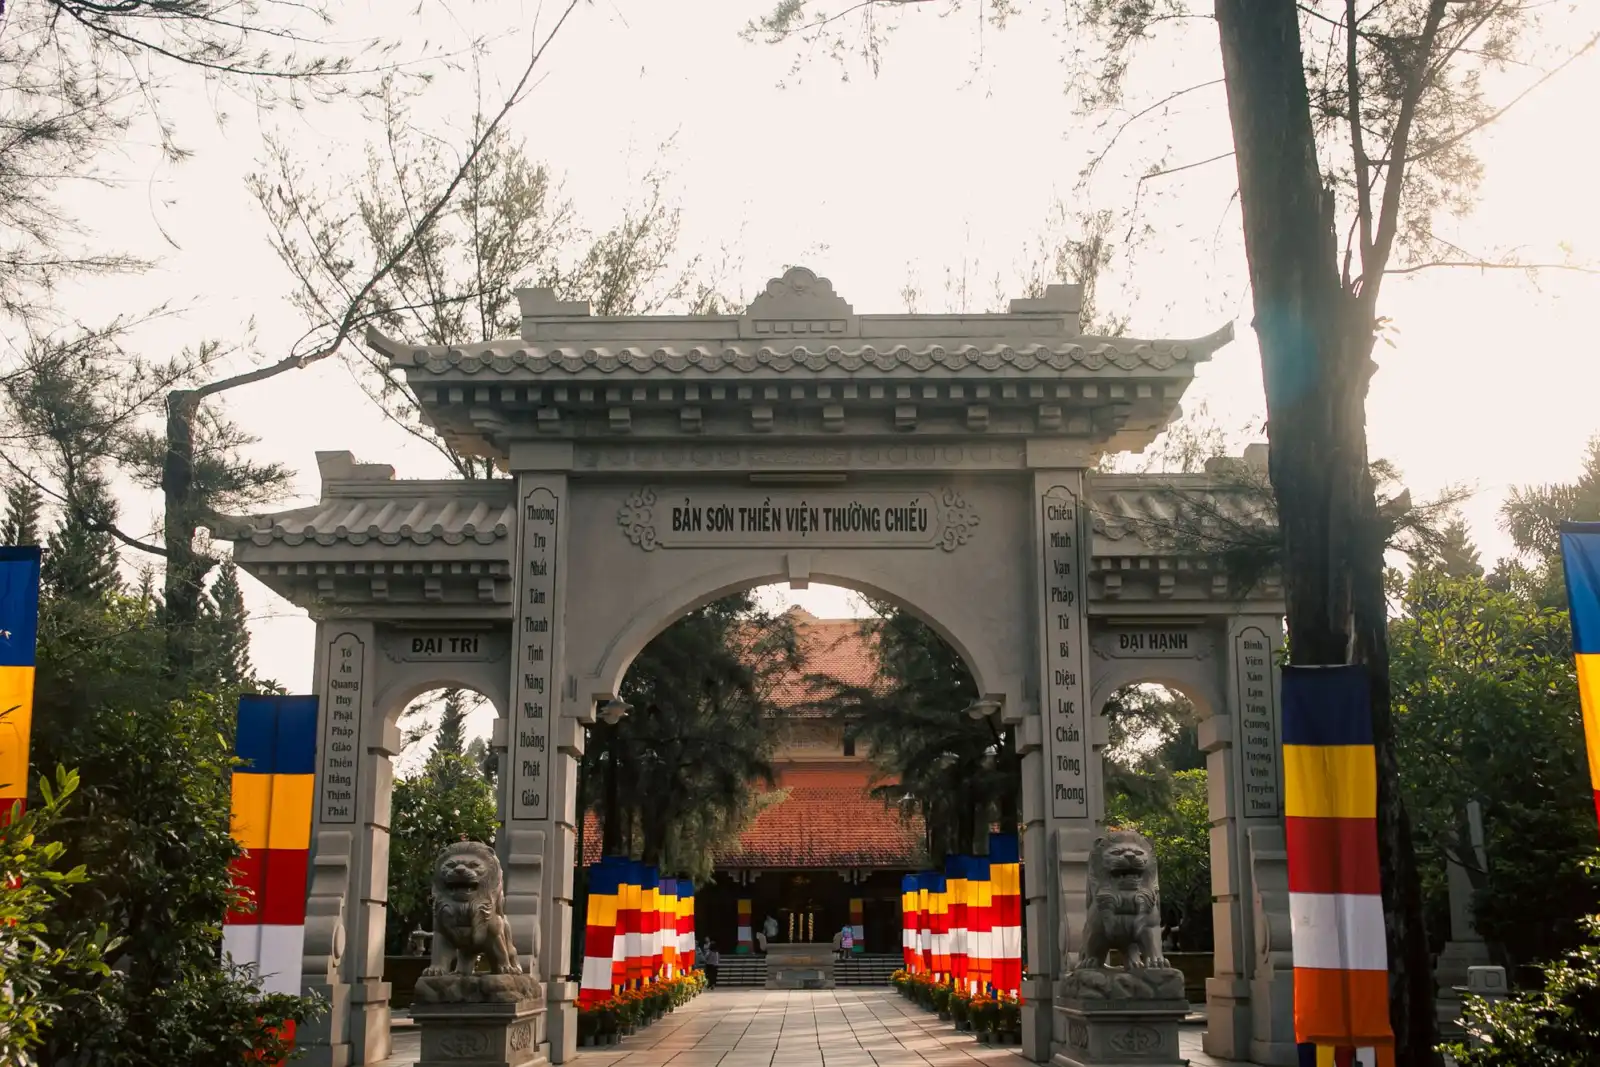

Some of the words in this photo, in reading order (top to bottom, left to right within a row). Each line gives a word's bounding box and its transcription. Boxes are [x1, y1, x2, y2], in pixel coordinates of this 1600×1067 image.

[527, 503, 555, 525] Thường
[672, 497, 702, 532] BẢN
[706, 504, 734, 532] SƠN
[739, 497, 781, 532] THIỀN
[786, 500, 819, 537] VIỆN
[823, 500, 881, 532] THƯỜNG
[885, 498, 928, 532] CHIẾU
[1047, 501, 1073, 521] Chiếu
[533, 532, 546, 552] Trụ
[1053, 559, 1071, 579] Vạn
[1051, 585, 1074, 607] Pháp
[525, 616, 548, 633] Thanh
[412, 637, 443, 656] ĐẠI
[448, 632, 479, 653] TRÍ
[1119, 633, 1144, 653] ĐẠI
[1148, 633, 1188, 653] HẠNH
[527, 644, 544, 665] Tịnh
[331, 679, 359, 691] Quang
[1055, 670, 1076, 690] Diệu
[335, 695, 353, 707] Huy
[1058, 698, 1075, 719] Lực
[331, 725, 354, 739] Pháp
[1056, 723, 1079, 743] Chấn
[1057, 755, 1081, 776] Tông
[521, 788, 540, 807] Giáo
[1055, 783, 1085, 805] Phong
